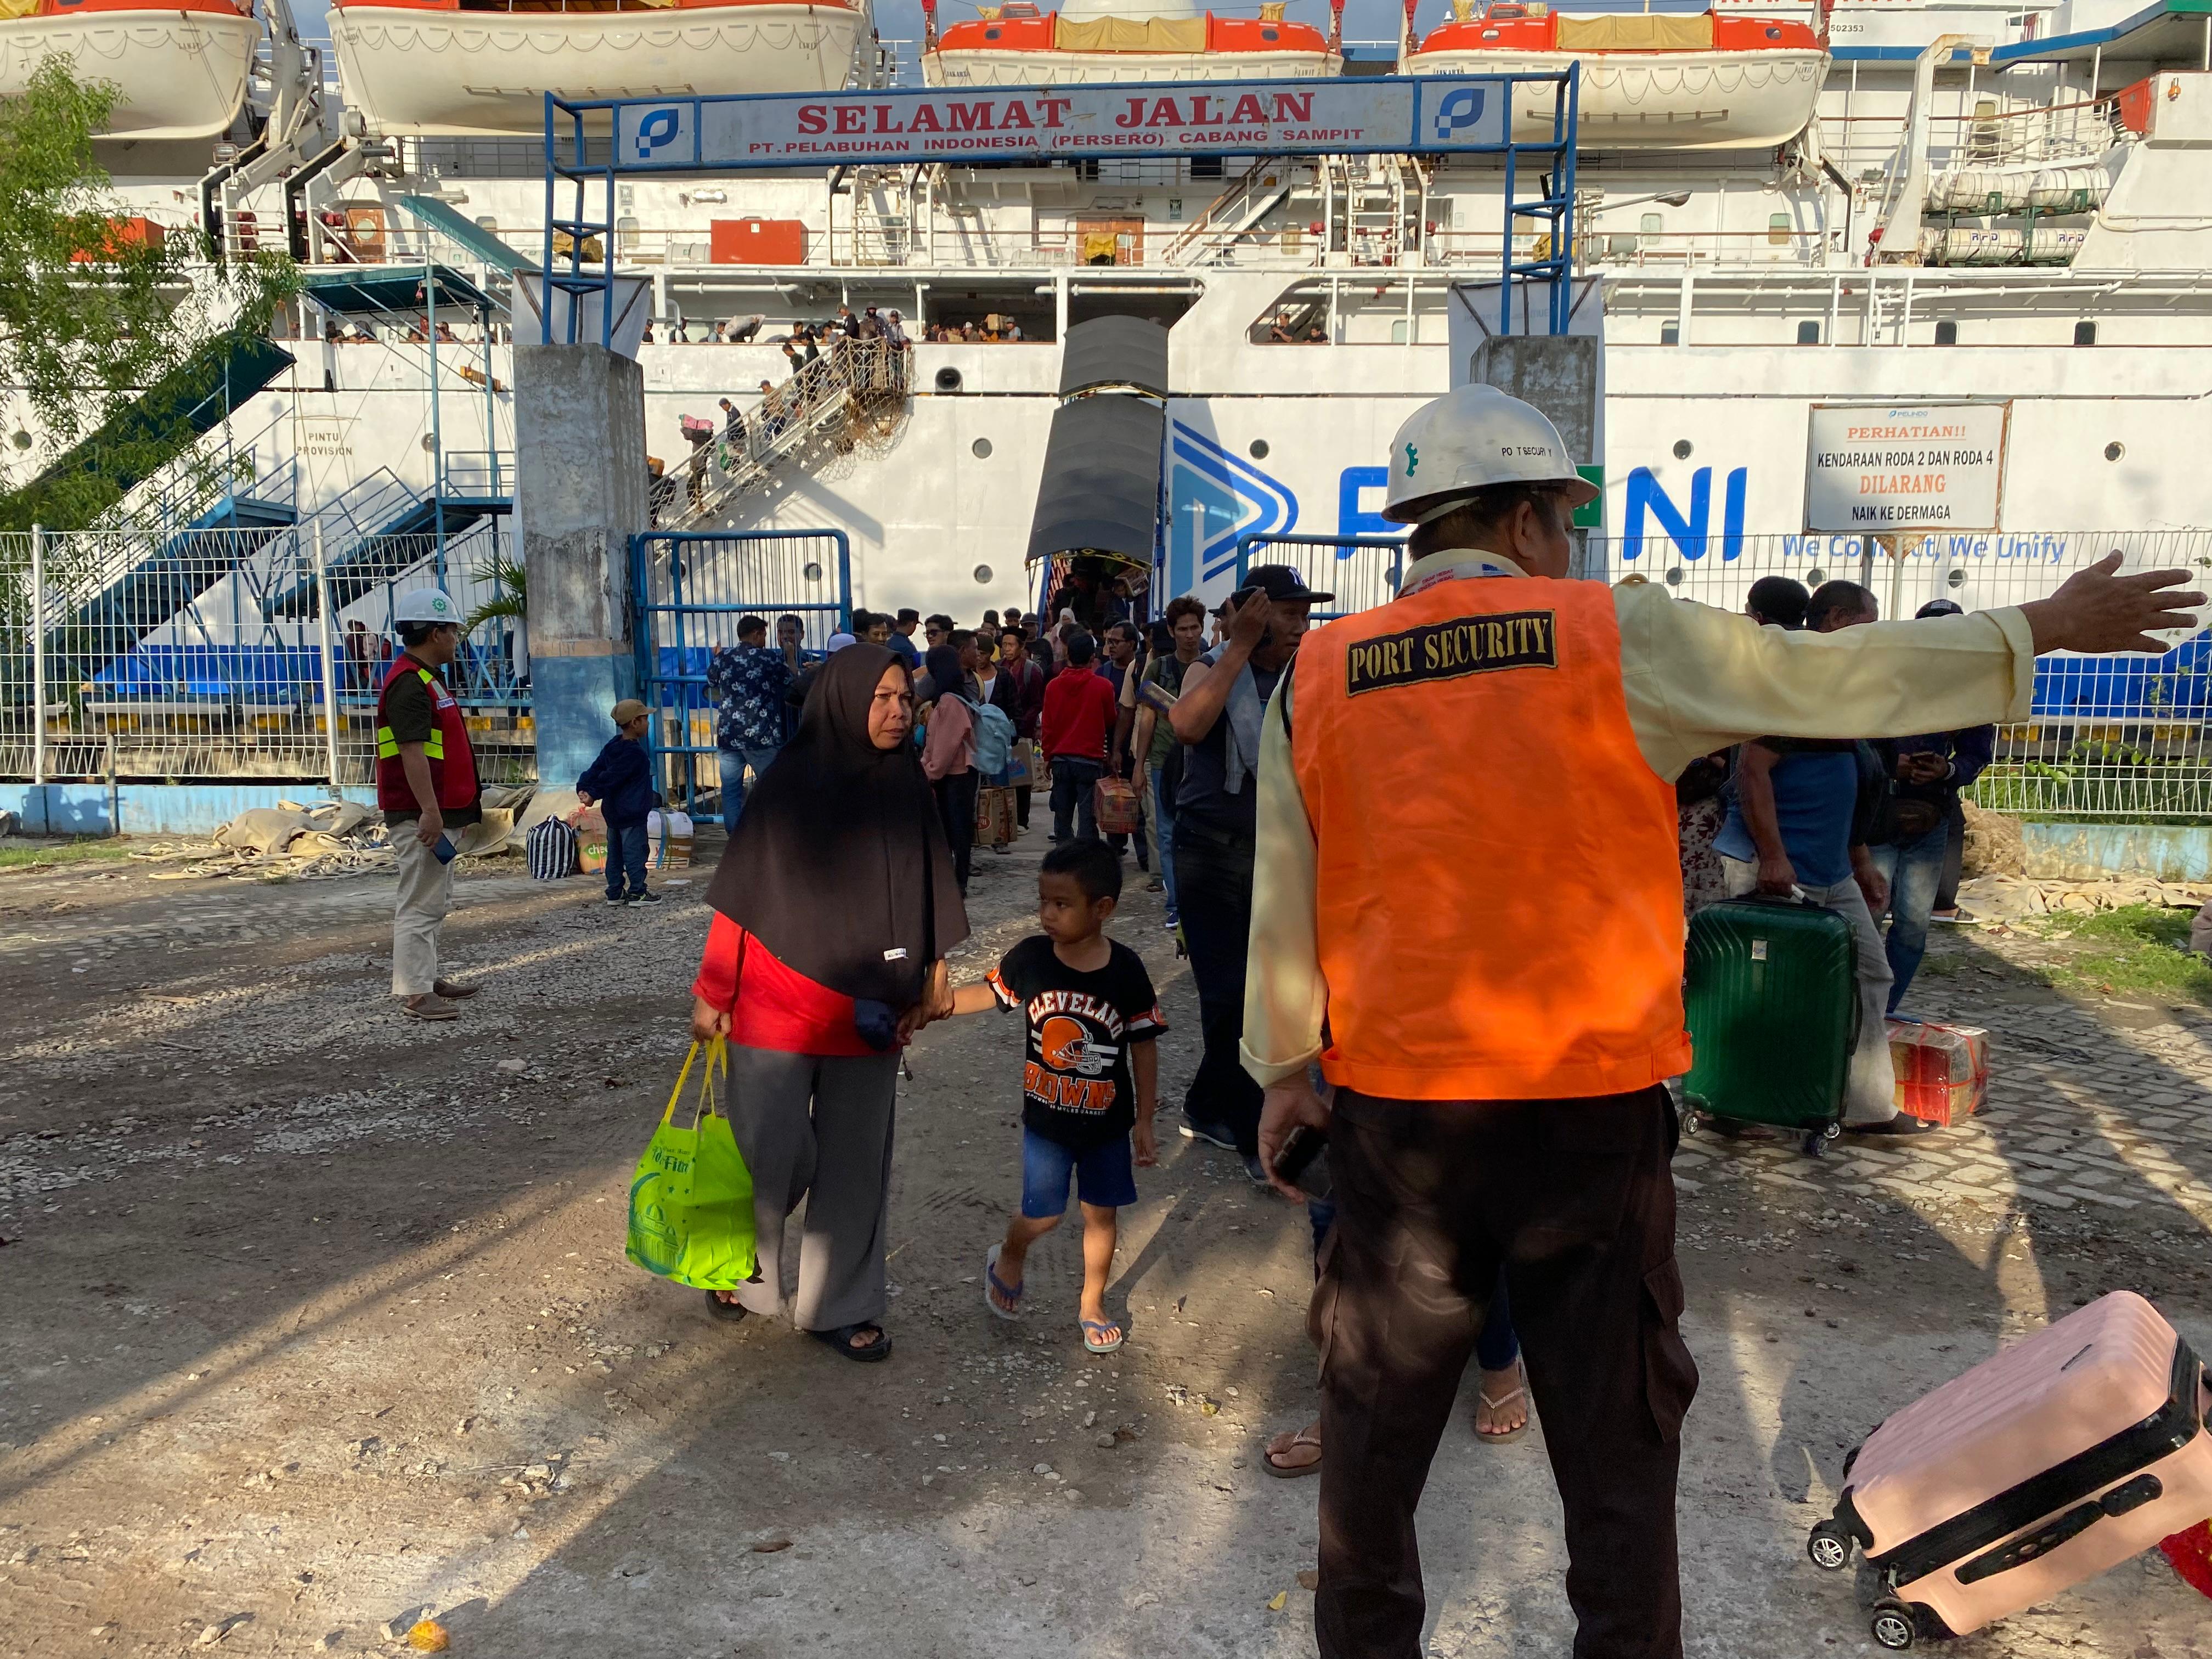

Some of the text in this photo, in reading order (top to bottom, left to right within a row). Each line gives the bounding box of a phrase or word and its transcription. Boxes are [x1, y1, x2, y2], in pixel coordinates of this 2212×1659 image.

[798, 92, 1315, 134] SELAMAT JALAN
[924, 135, 1039, 150] INDONESIA
[1052, 132, 1164, 149] (PERSERO)
[1178, 130, 1268, 143] CABANG
[1282, 128, 1364, 140] SAMPIT
[308, 432, 339, 442] PINTU
[1847, 425, 1966, 439] PERHATIAN!!
[297, 446, 352, 455] PROVISION
[1818, 450, 1994, 467] KENDARAAN RODA 2 DAN RODA 4
[1859, 474, 1946, 494] DILARANG
[1852, 505, 1951, 521] NAIK KE DERMAGA
[1782, 535, 1820, 557] We
[1949, 536, 1988, 557] We
[1998, 535, 2066, 563] Unify
[1351, 618, 1549, 682] PORT SECURITY
[1028, 990, 1124, 1041] CLEVELAND
